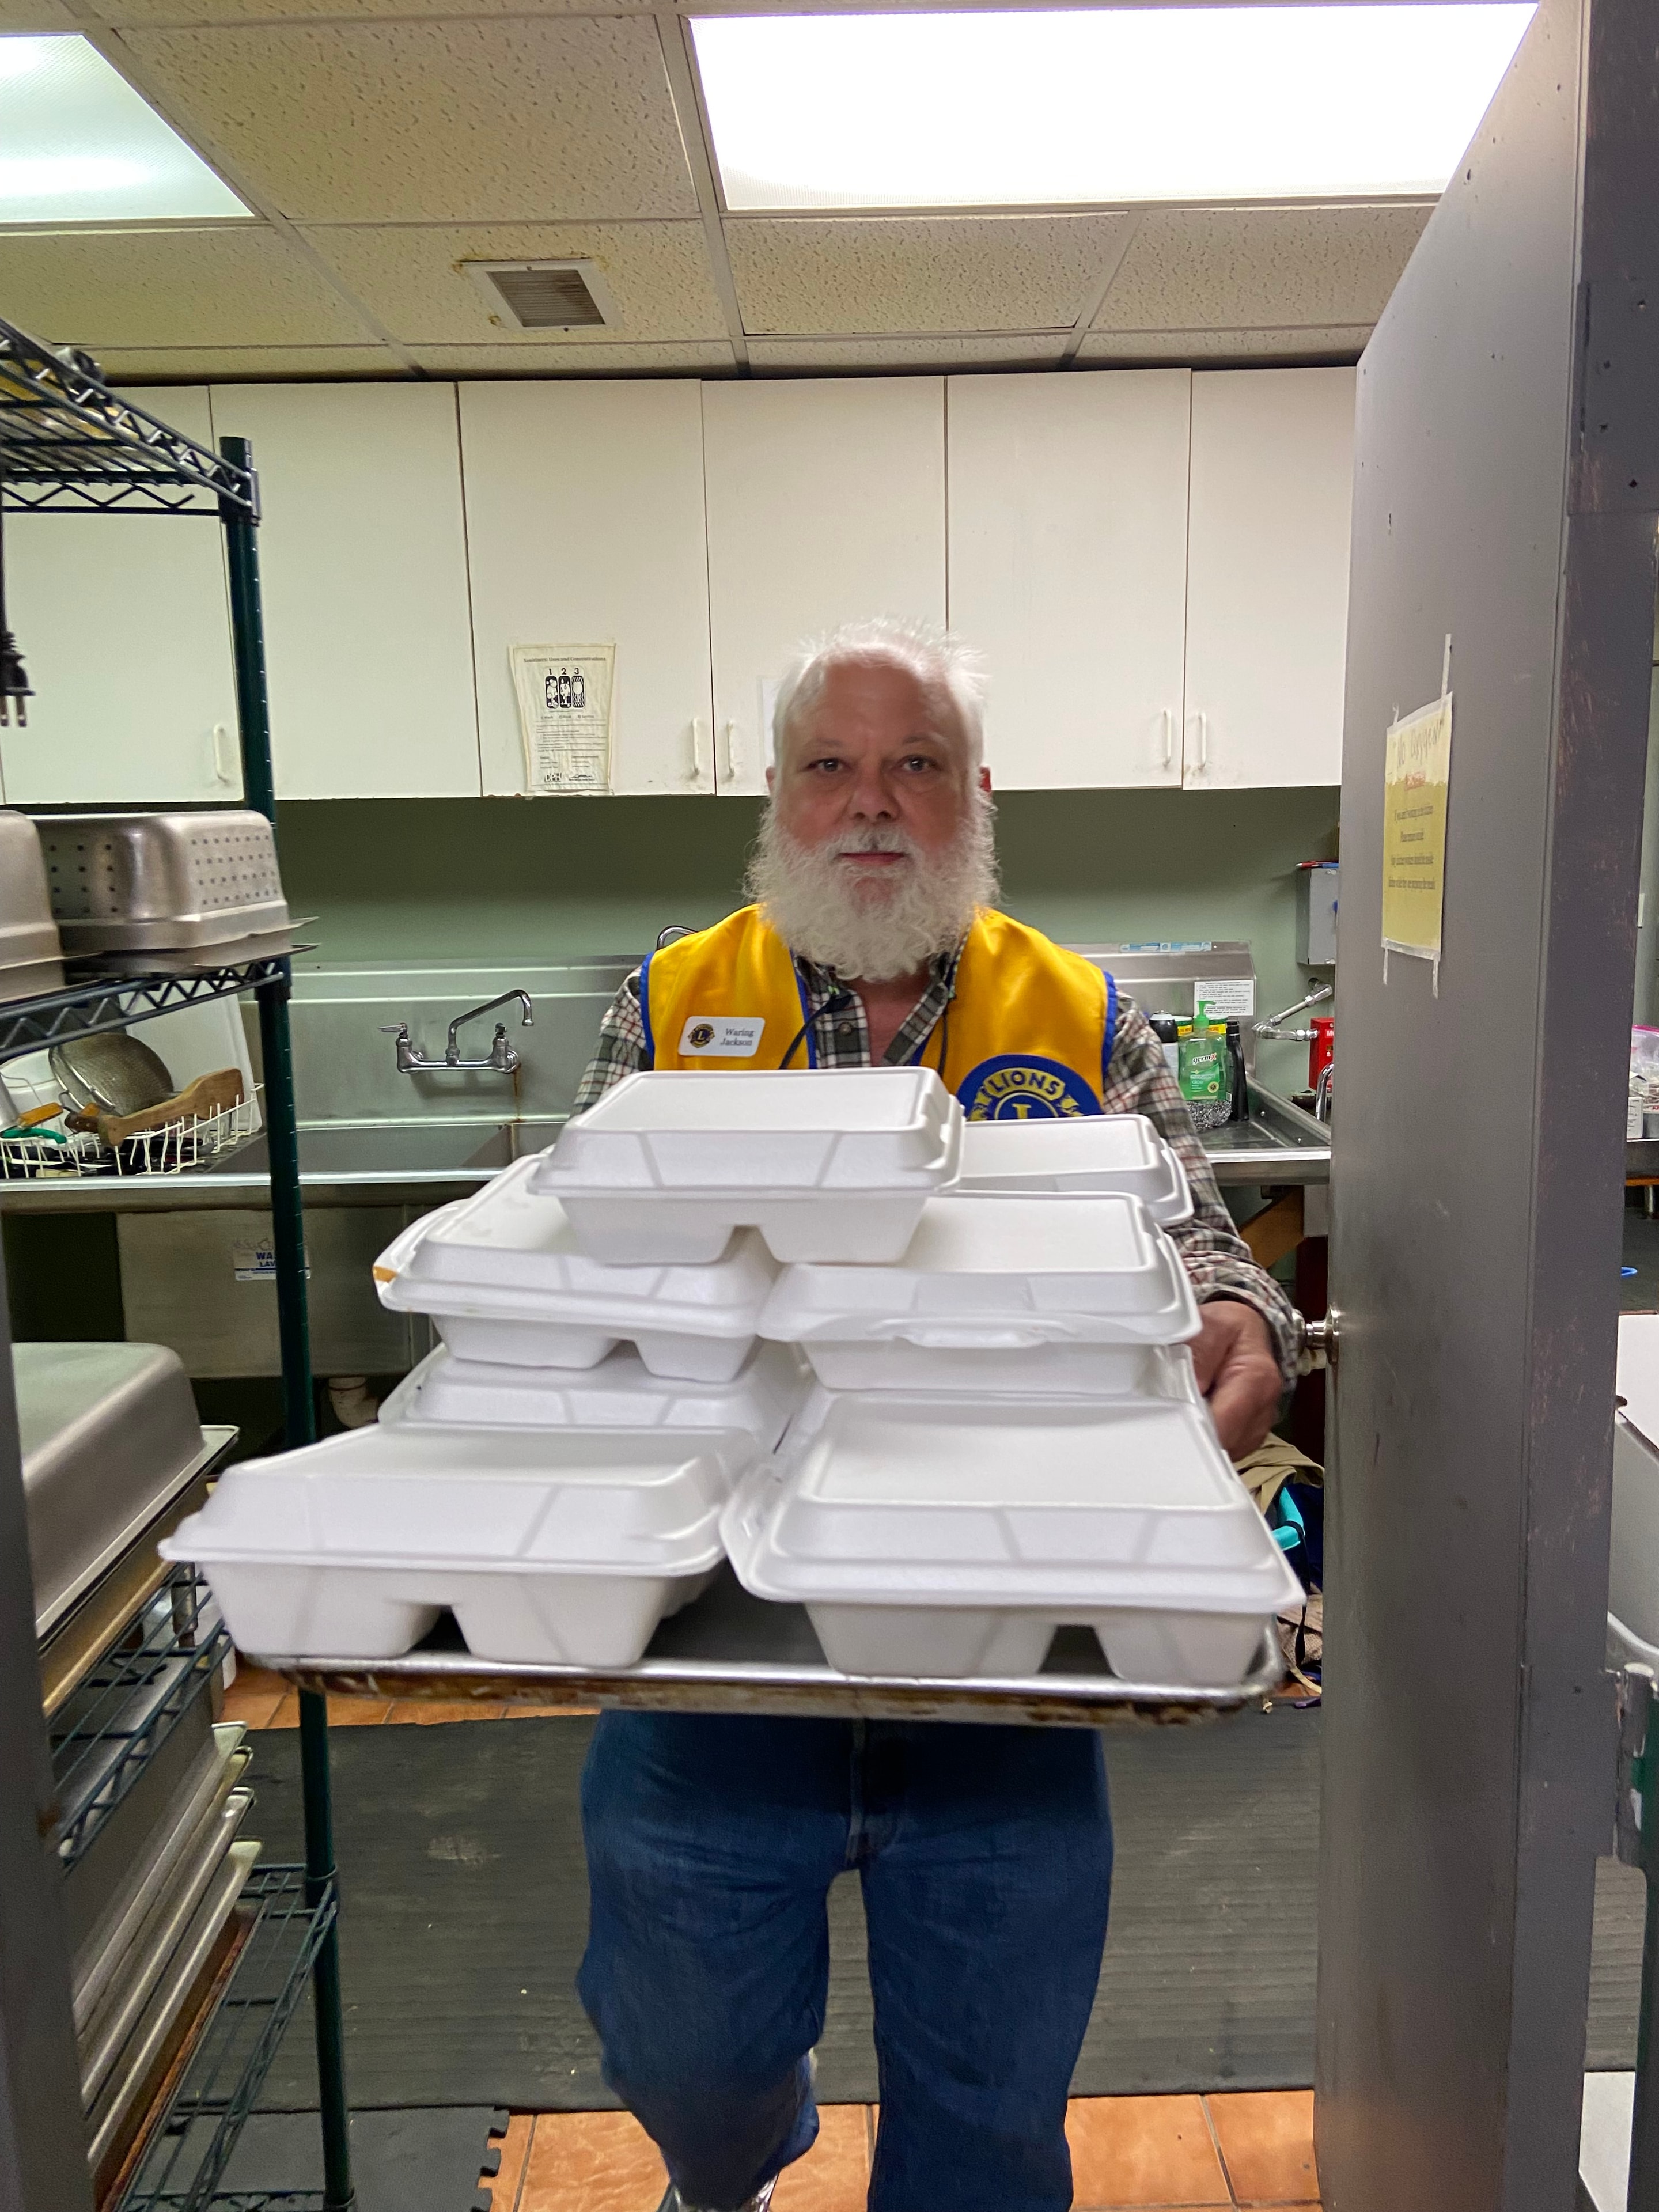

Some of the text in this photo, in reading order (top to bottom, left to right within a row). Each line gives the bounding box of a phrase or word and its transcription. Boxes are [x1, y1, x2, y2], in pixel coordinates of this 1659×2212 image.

[726, 1028, 754, 1037] Waring
[720, 1037, 752, 1046] Jackson
[988, 1070, 1060, 1095] LIONS
